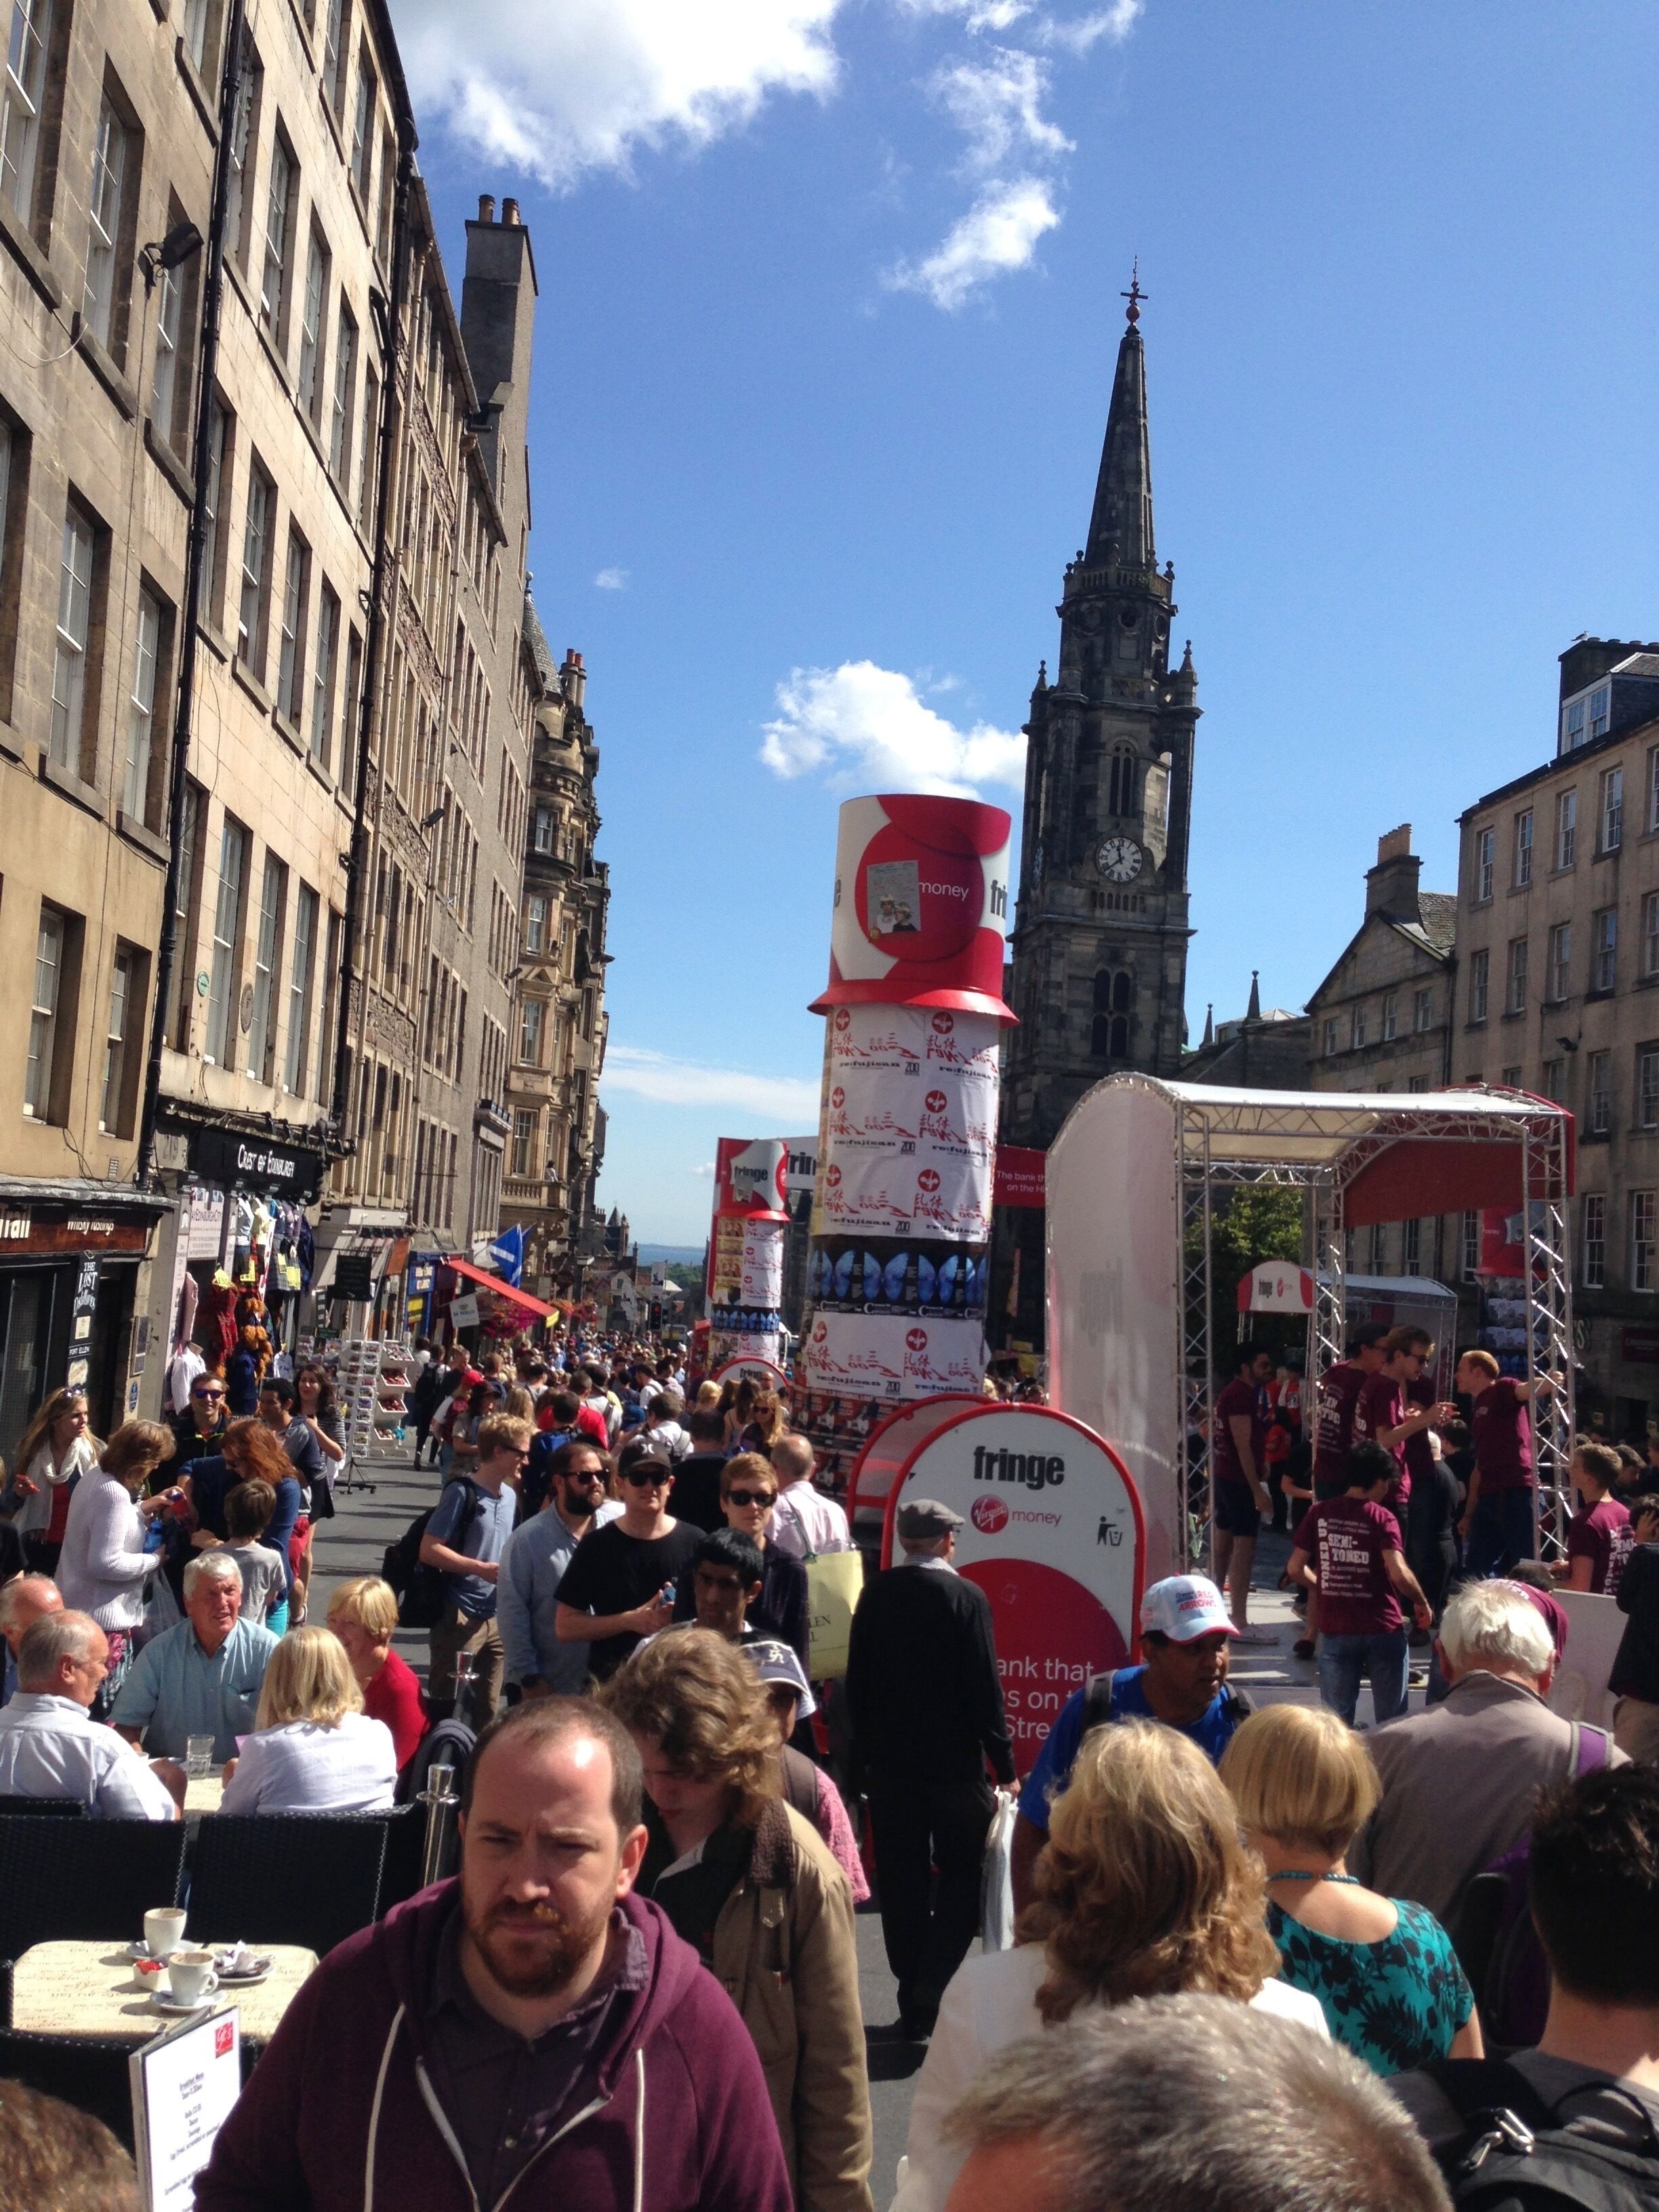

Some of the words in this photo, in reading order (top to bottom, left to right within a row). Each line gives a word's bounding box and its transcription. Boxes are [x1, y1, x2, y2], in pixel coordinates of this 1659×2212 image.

[918, 882, 969, 901] money
[990, 880, 1007, 919] fri
[997, 1170, 1012, 1180] The
[1015, 1172, 1036, 1182] bank
[1020, 1185, 1034, 1193] the
[84, 1262, 96, 1272] THE
[78, 1271, 98, 1293] LOST
[740, 1368, 762, 1380] fring
[974, 1446, 1065, 1490] fringe
[974, 1498, 1008, 1529] Virgin
[1012, 1510, 1062, 1528] money
[1328, 1533, 1358, 1549] SEMI-
[1332, 1548, 1370, 1565] TONED
[809, 1615, 831, 1628] LEN
[997, 1656, 1038, 1679] ank
[1044, 1658, 1094, 1682] that
[1027, 1691, 1059, 1711] on
[1004, 1714, 1050, 1740] Stre
